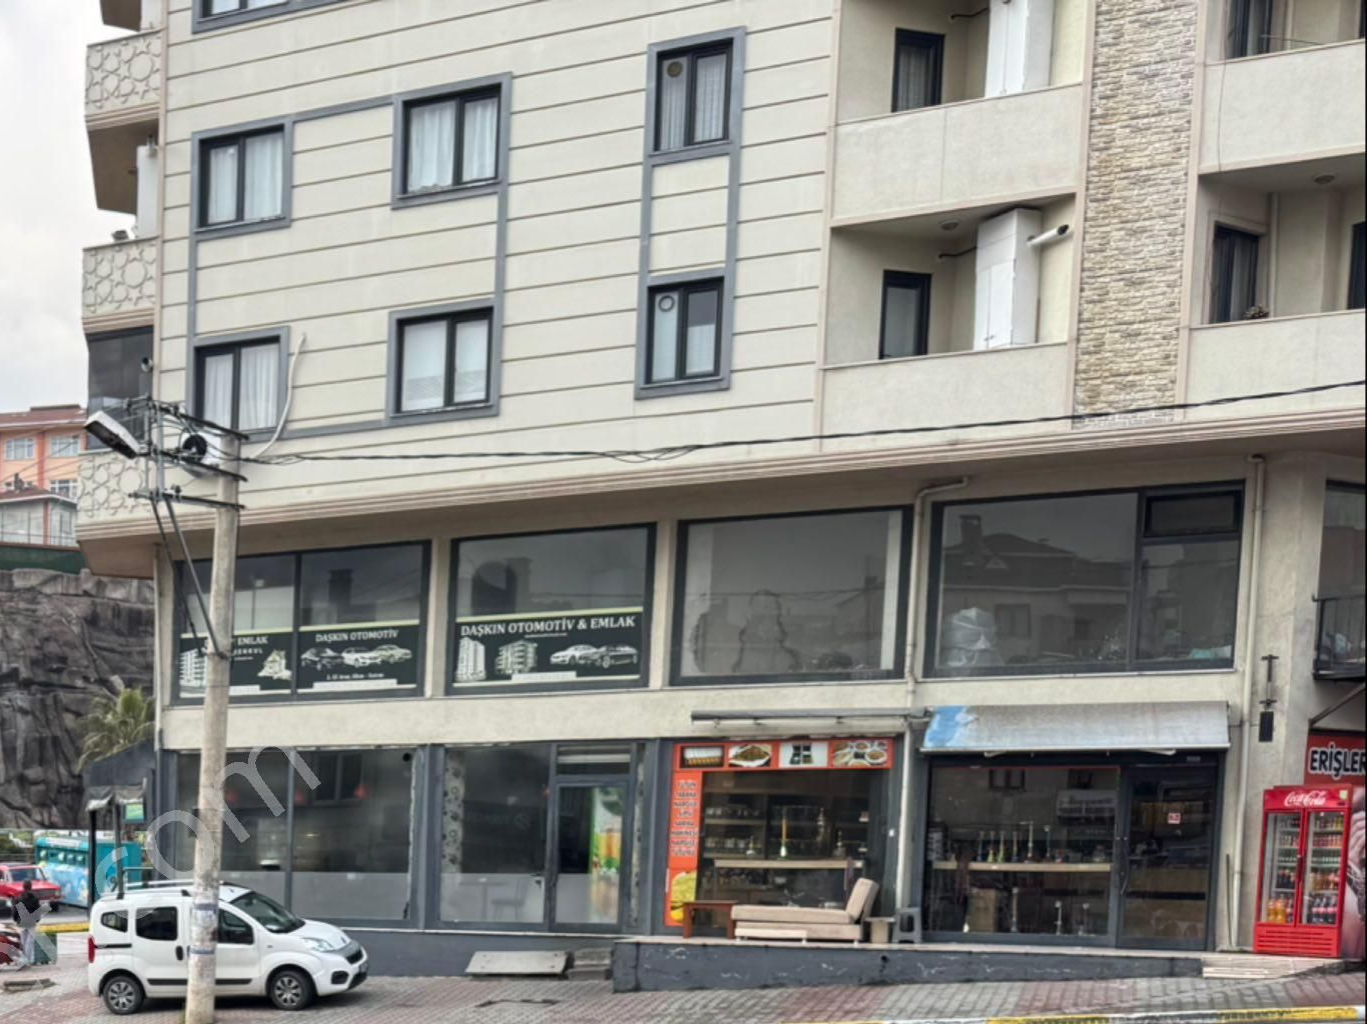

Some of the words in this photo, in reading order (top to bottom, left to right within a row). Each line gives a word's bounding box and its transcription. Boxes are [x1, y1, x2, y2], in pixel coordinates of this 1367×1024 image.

[461, 623, 506, 638] DAŞKIN
[508, 617, 575, 634] OTOMOTİV
[577, 619, 587, 630] &
[590, 615, 636, 629] EMLAK
[315, 633, 348, 643] DAŞKIN
[350, 629, 399, 640] OTOMOTİV
